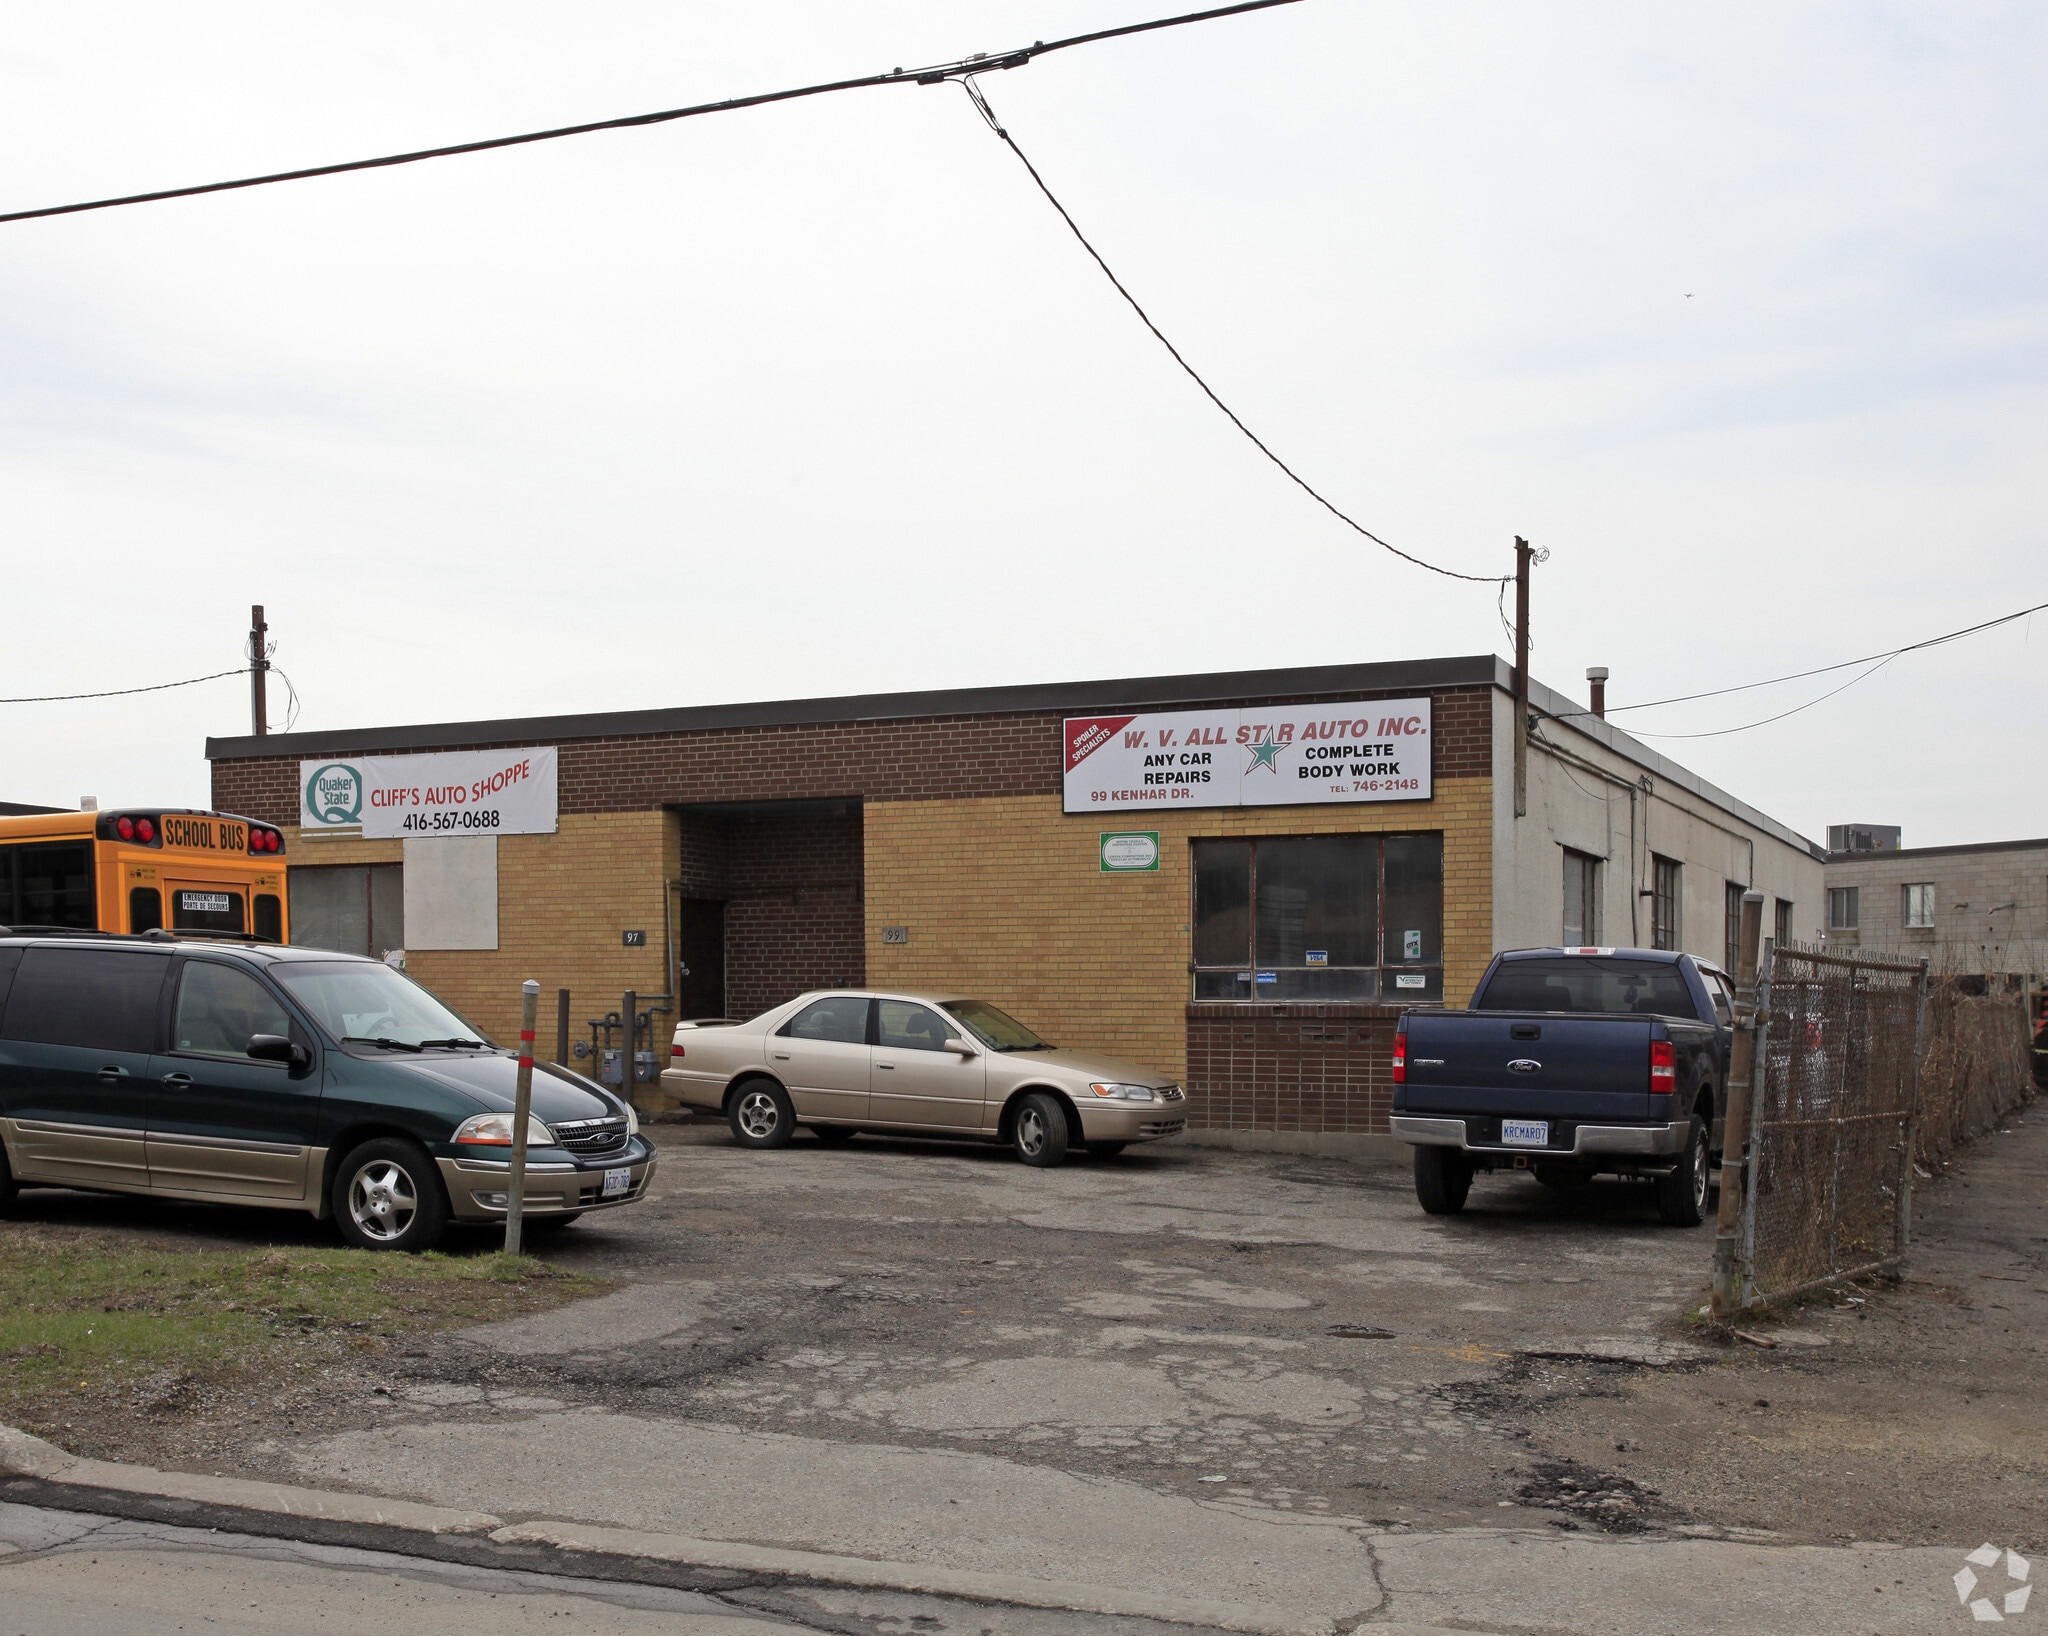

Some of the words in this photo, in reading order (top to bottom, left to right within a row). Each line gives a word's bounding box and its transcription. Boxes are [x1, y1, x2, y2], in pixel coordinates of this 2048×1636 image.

[1073, 724, 1099, 748] SPOILER
[1124, 731, 1149, 748] W.
[1159, 729, 1177, 746] V.
[1185, 726, 1228, 745] ALL
[1300, 719, 1369, 741] AUTO
[1376, 716, 1427, 736] INC.
[1072, 728, 1111, 762] SPECIALISTS
[1305, 744, 1394, 759] COMPLETE
[1144, 754, 1176, 767] ANY
[1180, 752, 1212, 766] CAR
[1298, 765, 1344, 779] BODY
[1350, 762, 1400, 776] WORK
[319, 777, 353, 793] Quaker
[371, 788, 420, 807] CLIFF'S
[424, 785, 467, 805] AUTO
[472, 759, 530, 802] SHOPPE
[1144, 771, 1211, 785] REPAIRS
[1353, 779, 1419, 792] 746-2148
[324, 791, 350, 805] State
[1091, 792, 1107, 802] 99
[1111, 789, 1167, 801] KENHAR
[1171, 788, 1194, 799] DR.
[403, 810, 500, 831] 416-567-0688
[165, 819, 216, 849] SCHOOL
[219, 823, 245, 851] BUS
[184, 893, 214, 903] EMERGENCY
[207, 903, 228, 911] SECOURS
[627, 932, 639, 943] 97
[888, 930, 900, 940] 99
[1406, 940, 1419, 949] GTX
[1514, 1062, 1533, 1071] Ford
